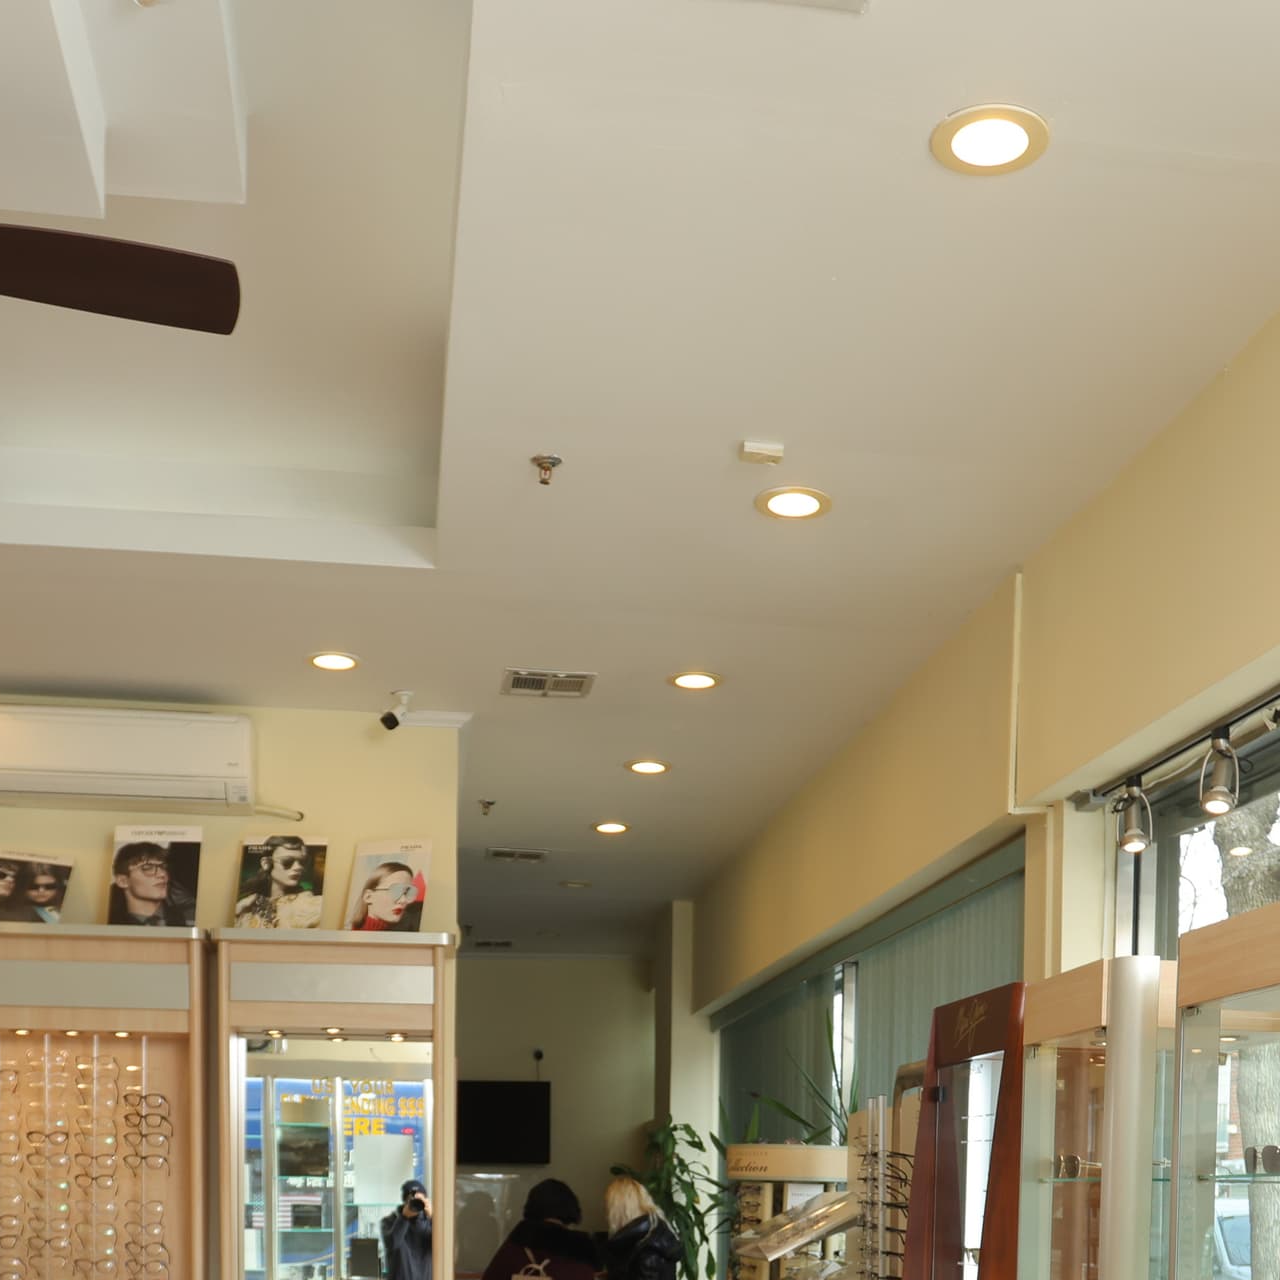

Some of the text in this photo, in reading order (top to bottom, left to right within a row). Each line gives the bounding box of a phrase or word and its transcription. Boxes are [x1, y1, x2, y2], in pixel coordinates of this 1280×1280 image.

[312, 1079, 395, 1095] US YOUR
[343, 1116, 385, 1136] ERE
